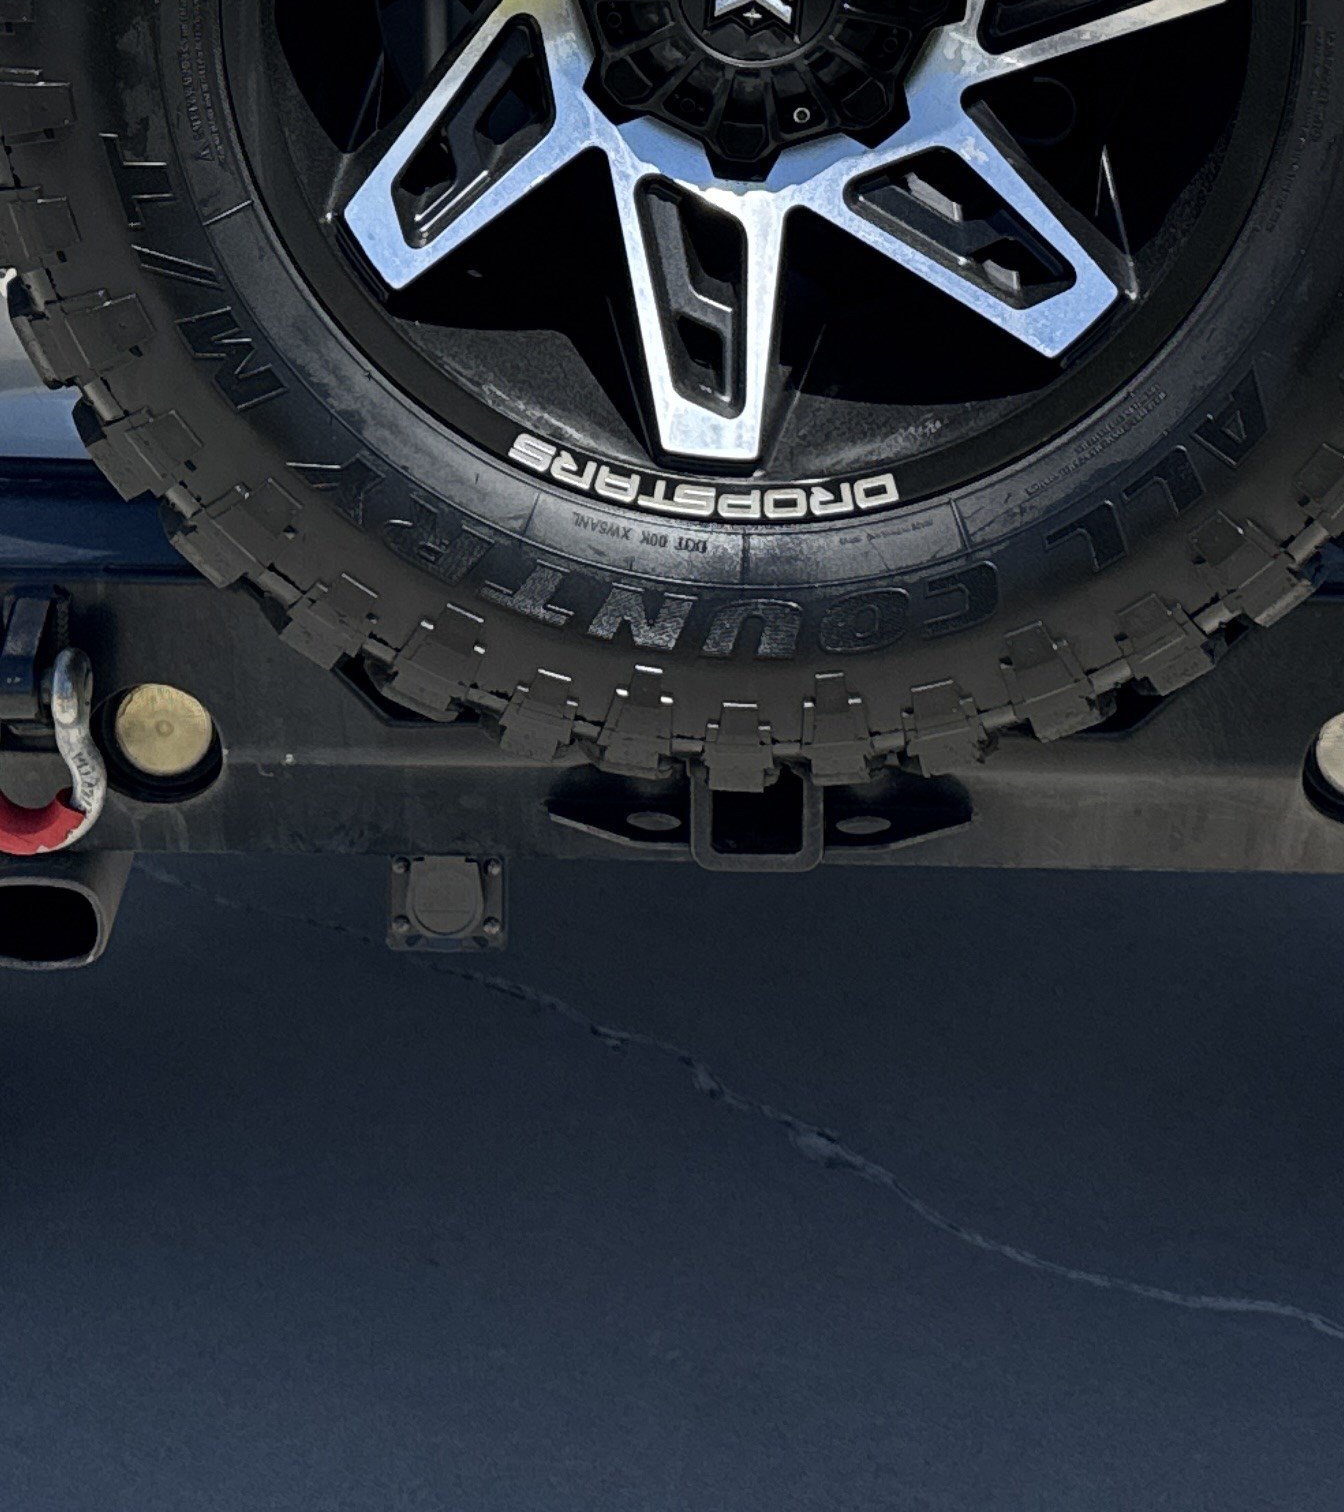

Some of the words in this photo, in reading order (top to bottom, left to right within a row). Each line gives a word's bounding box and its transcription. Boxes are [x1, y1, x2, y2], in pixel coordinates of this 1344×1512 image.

[98, 130, 285, 412] M/T
[287, 454, 1011, 660] COUNTRY
[507, 433, 899, 519] DROPSTARS
[1043, 369, 1273, 574] ALL
